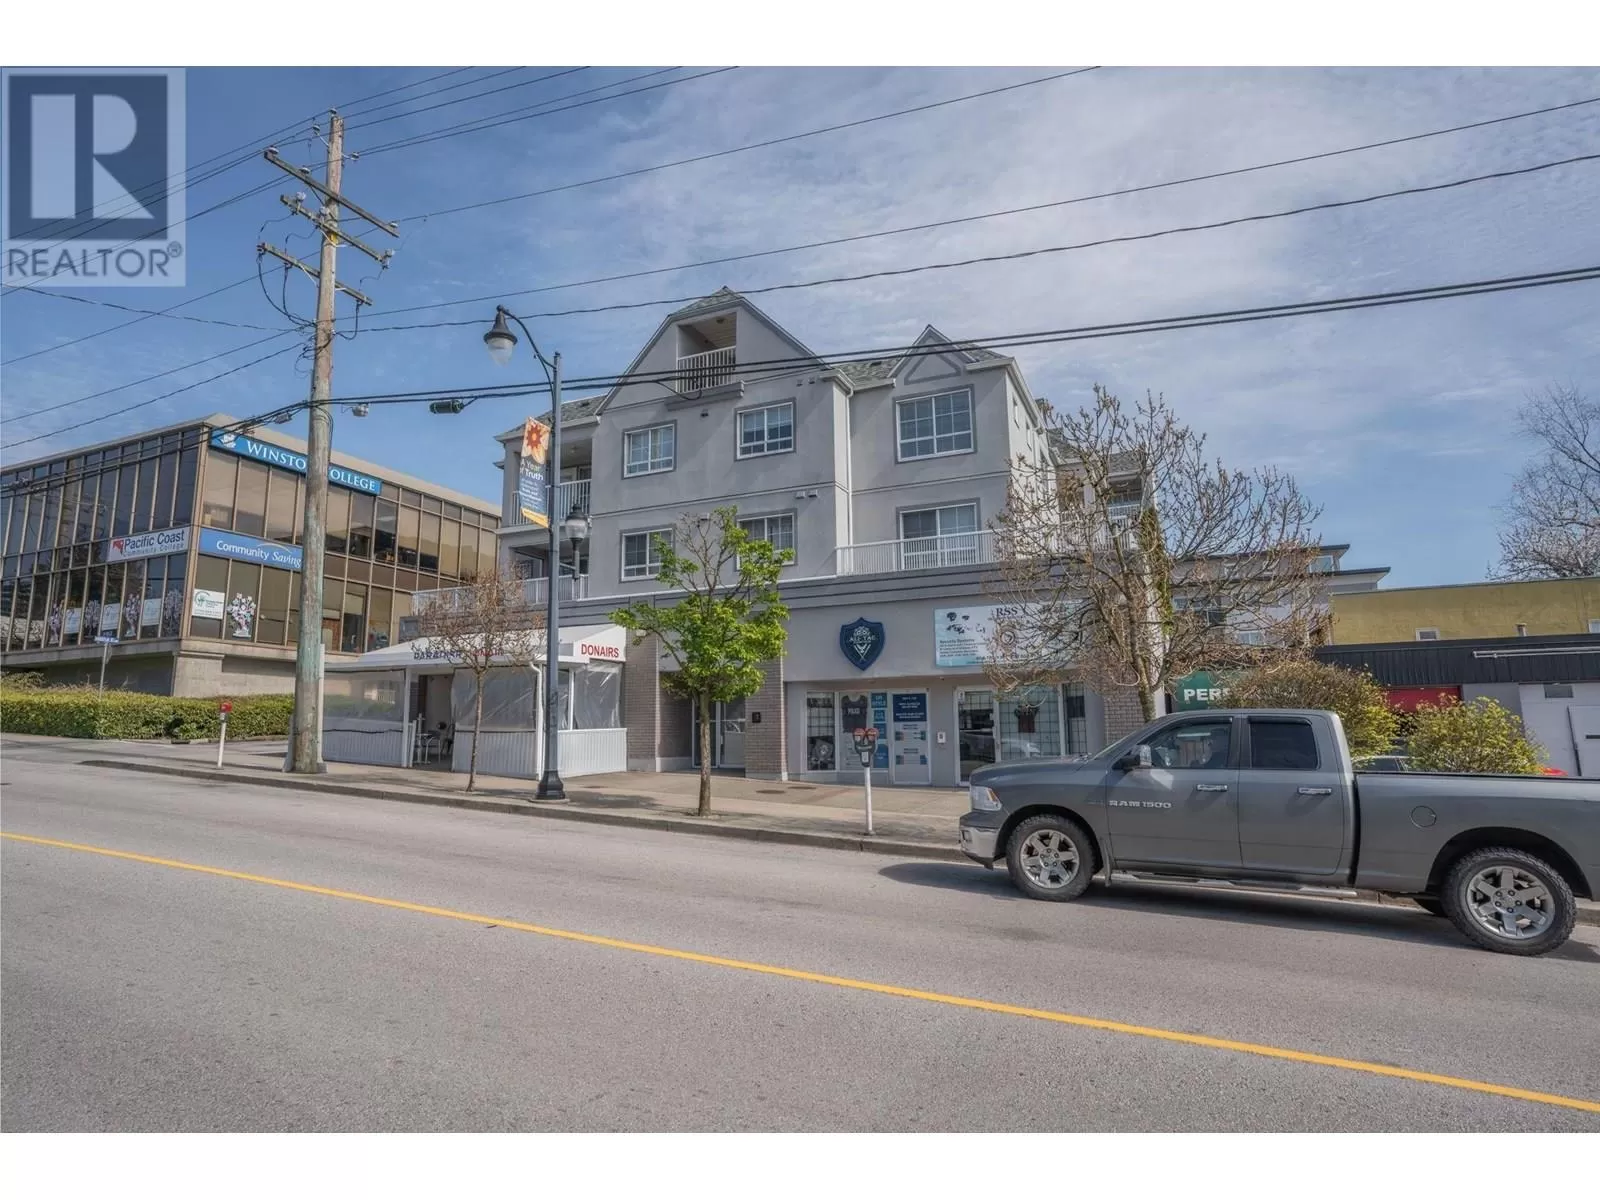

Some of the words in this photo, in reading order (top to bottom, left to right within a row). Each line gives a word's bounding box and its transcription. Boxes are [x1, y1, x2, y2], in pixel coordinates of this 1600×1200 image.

[246, 440, 307, 470] WINSTO
[328, 466, 376, 492] OLLEGE
[525, 468, 544, 481] Truth
[124, 535, 155, 551] Pacific
[157, 529, 185, 545] Coast
[216, 540, 270, 560] Community
[272, 551, 302, 568] Saving
[996, 606, 1019, 617] RSS
[581, 643, 620, 659] DONAIRS
[1109, 800, 1141, 808] RAM
[1142, 801, 1172, 809] 1500
